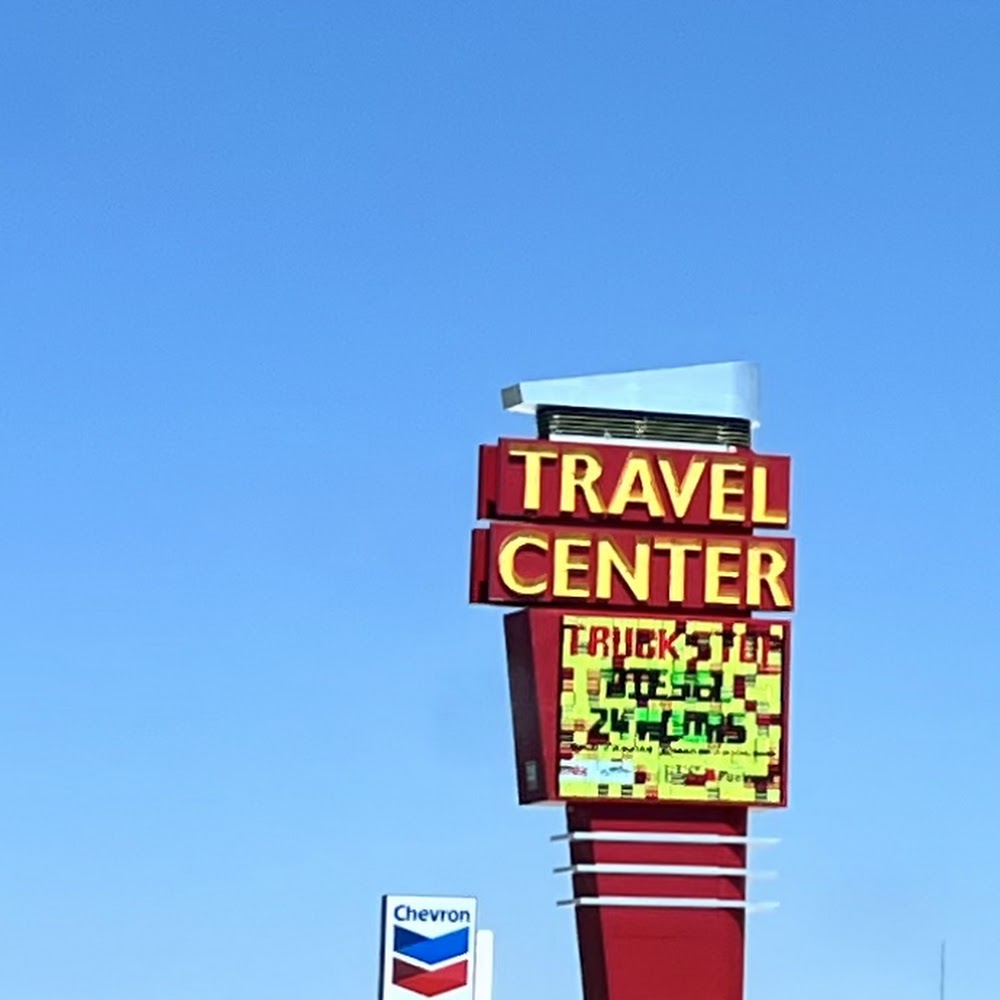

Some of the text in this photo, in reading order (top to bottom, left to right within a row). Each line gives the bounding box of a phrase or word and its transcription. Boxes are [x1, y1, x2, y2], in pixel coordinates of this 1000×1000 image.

[509, 447, 788, 525] TRAVEL
[498, 533, 792, 607] CENTER
[564, 625, 680, 660] TRUCK
[589, 708, 629, 744] 24
[394, 905, 470, 923] Chevron
